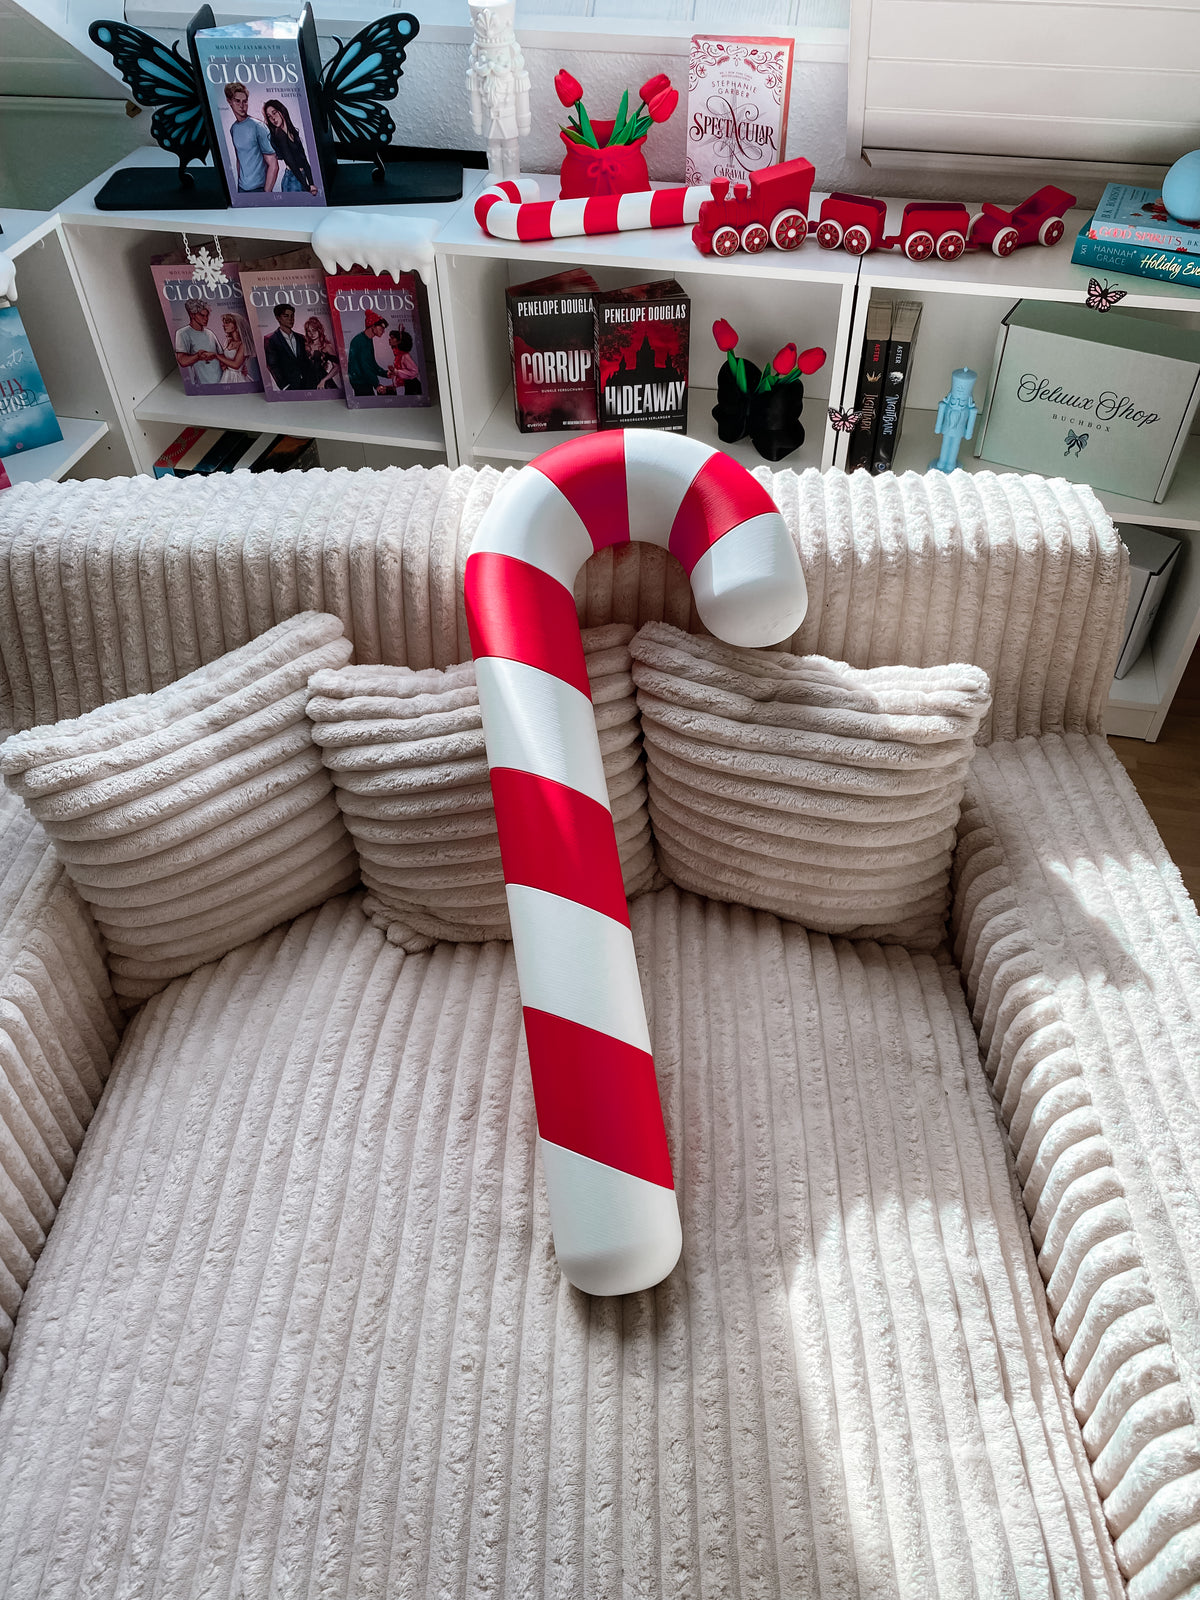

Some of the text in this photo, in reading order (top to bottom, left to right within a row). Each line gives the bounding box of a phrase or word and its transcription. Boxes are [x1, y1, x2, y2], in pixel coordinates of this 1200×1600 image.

[210, 54, 289, 63] PURPLE
[206, 63, 299, 84] CLOUDS
[711, 79, 758, 94] STEPHANIE
[717, 87, 750, 98] GARBER
[689, 112, 778, 151] SPECTACULAR
[713, 164, 747, 181] CARAVAL
[1099, 226, 1132, 239] GOOD
[1135, 231, 1183, 247] SPIRITS
[1093, 245, 1134, 259] HANNAH
[1096, 253, 1126, 266] GRACE
[1140, 253, 1183, 280] Holiday
[163, 282, 243, 302] CLOUDS
[250, 289, 329, 308] CLOUDS
[334, 295, 415, 312] CLOUDS
[518, 298, 594, 317] PENELOPE DOUGLA
[604, 304, 686, 324] PENELOPE DOUGLAS
[895, 345, 903, 364] ASTER
[521, 350, 594, 385] CORRUP
[605, 381, 686, 416] HIDEAWAY
[1095, 391, 1160, 427] Shop
[1052, 413, 1112, 432] BUCHBOX
